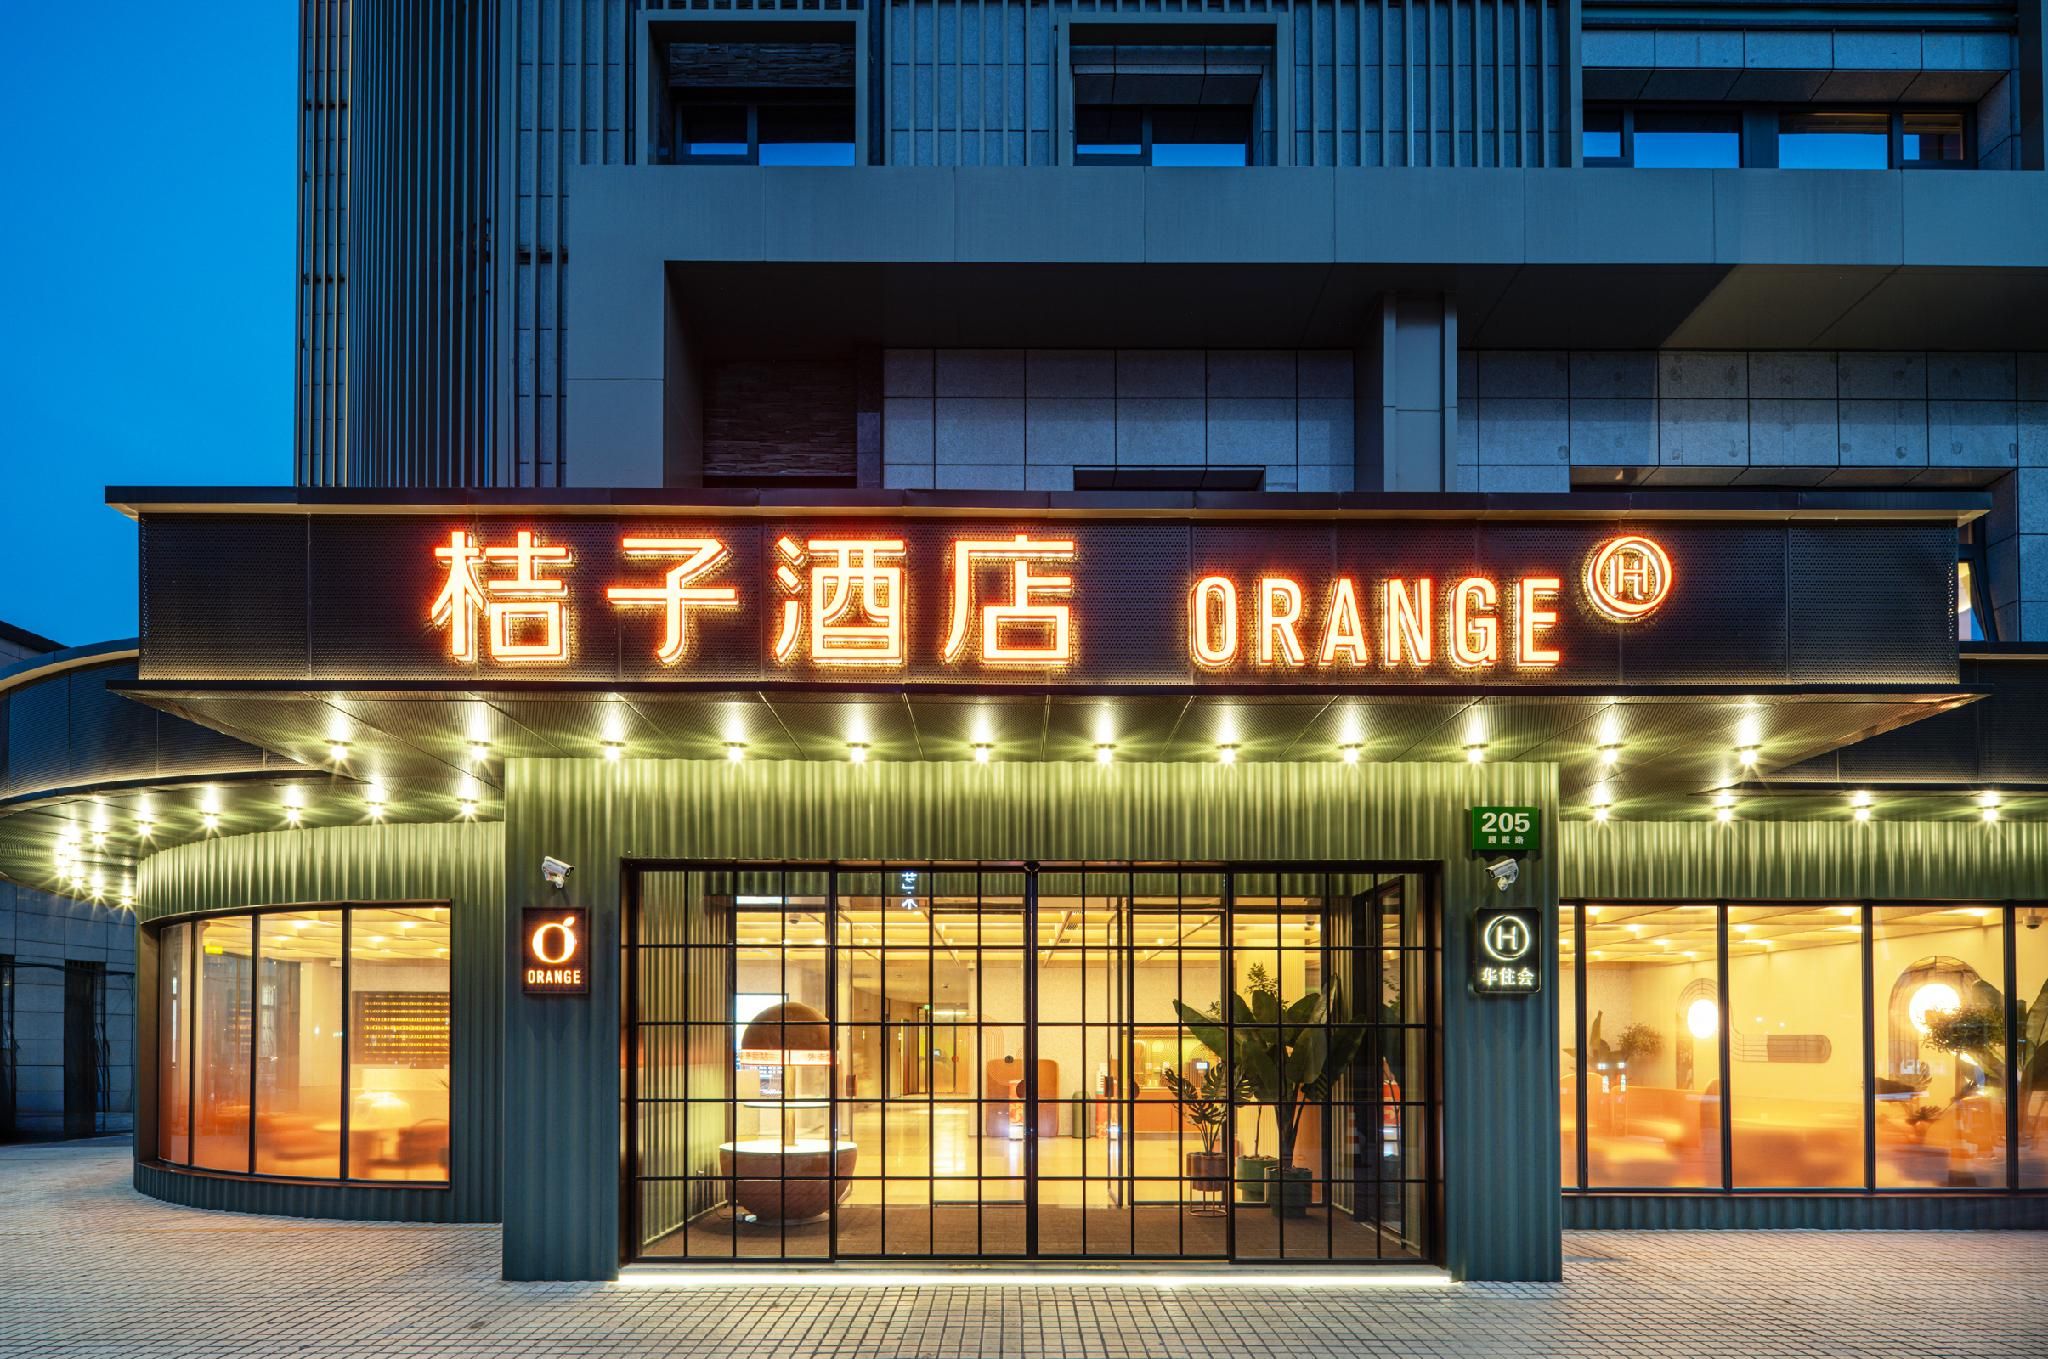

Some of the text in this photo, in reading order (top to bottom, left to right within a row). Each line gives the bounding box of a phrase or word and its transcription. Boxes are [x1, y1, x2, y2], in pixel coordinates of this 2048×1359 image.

[432, 530, 1076, 665] 桔子酒店
[1191, 576, 1560, 667] ORANGE
[1481, 812, 1530, 833] 205
[528, 970, 580, 984] ORANGE
[1482, 967, 1534, 986] 华住会
